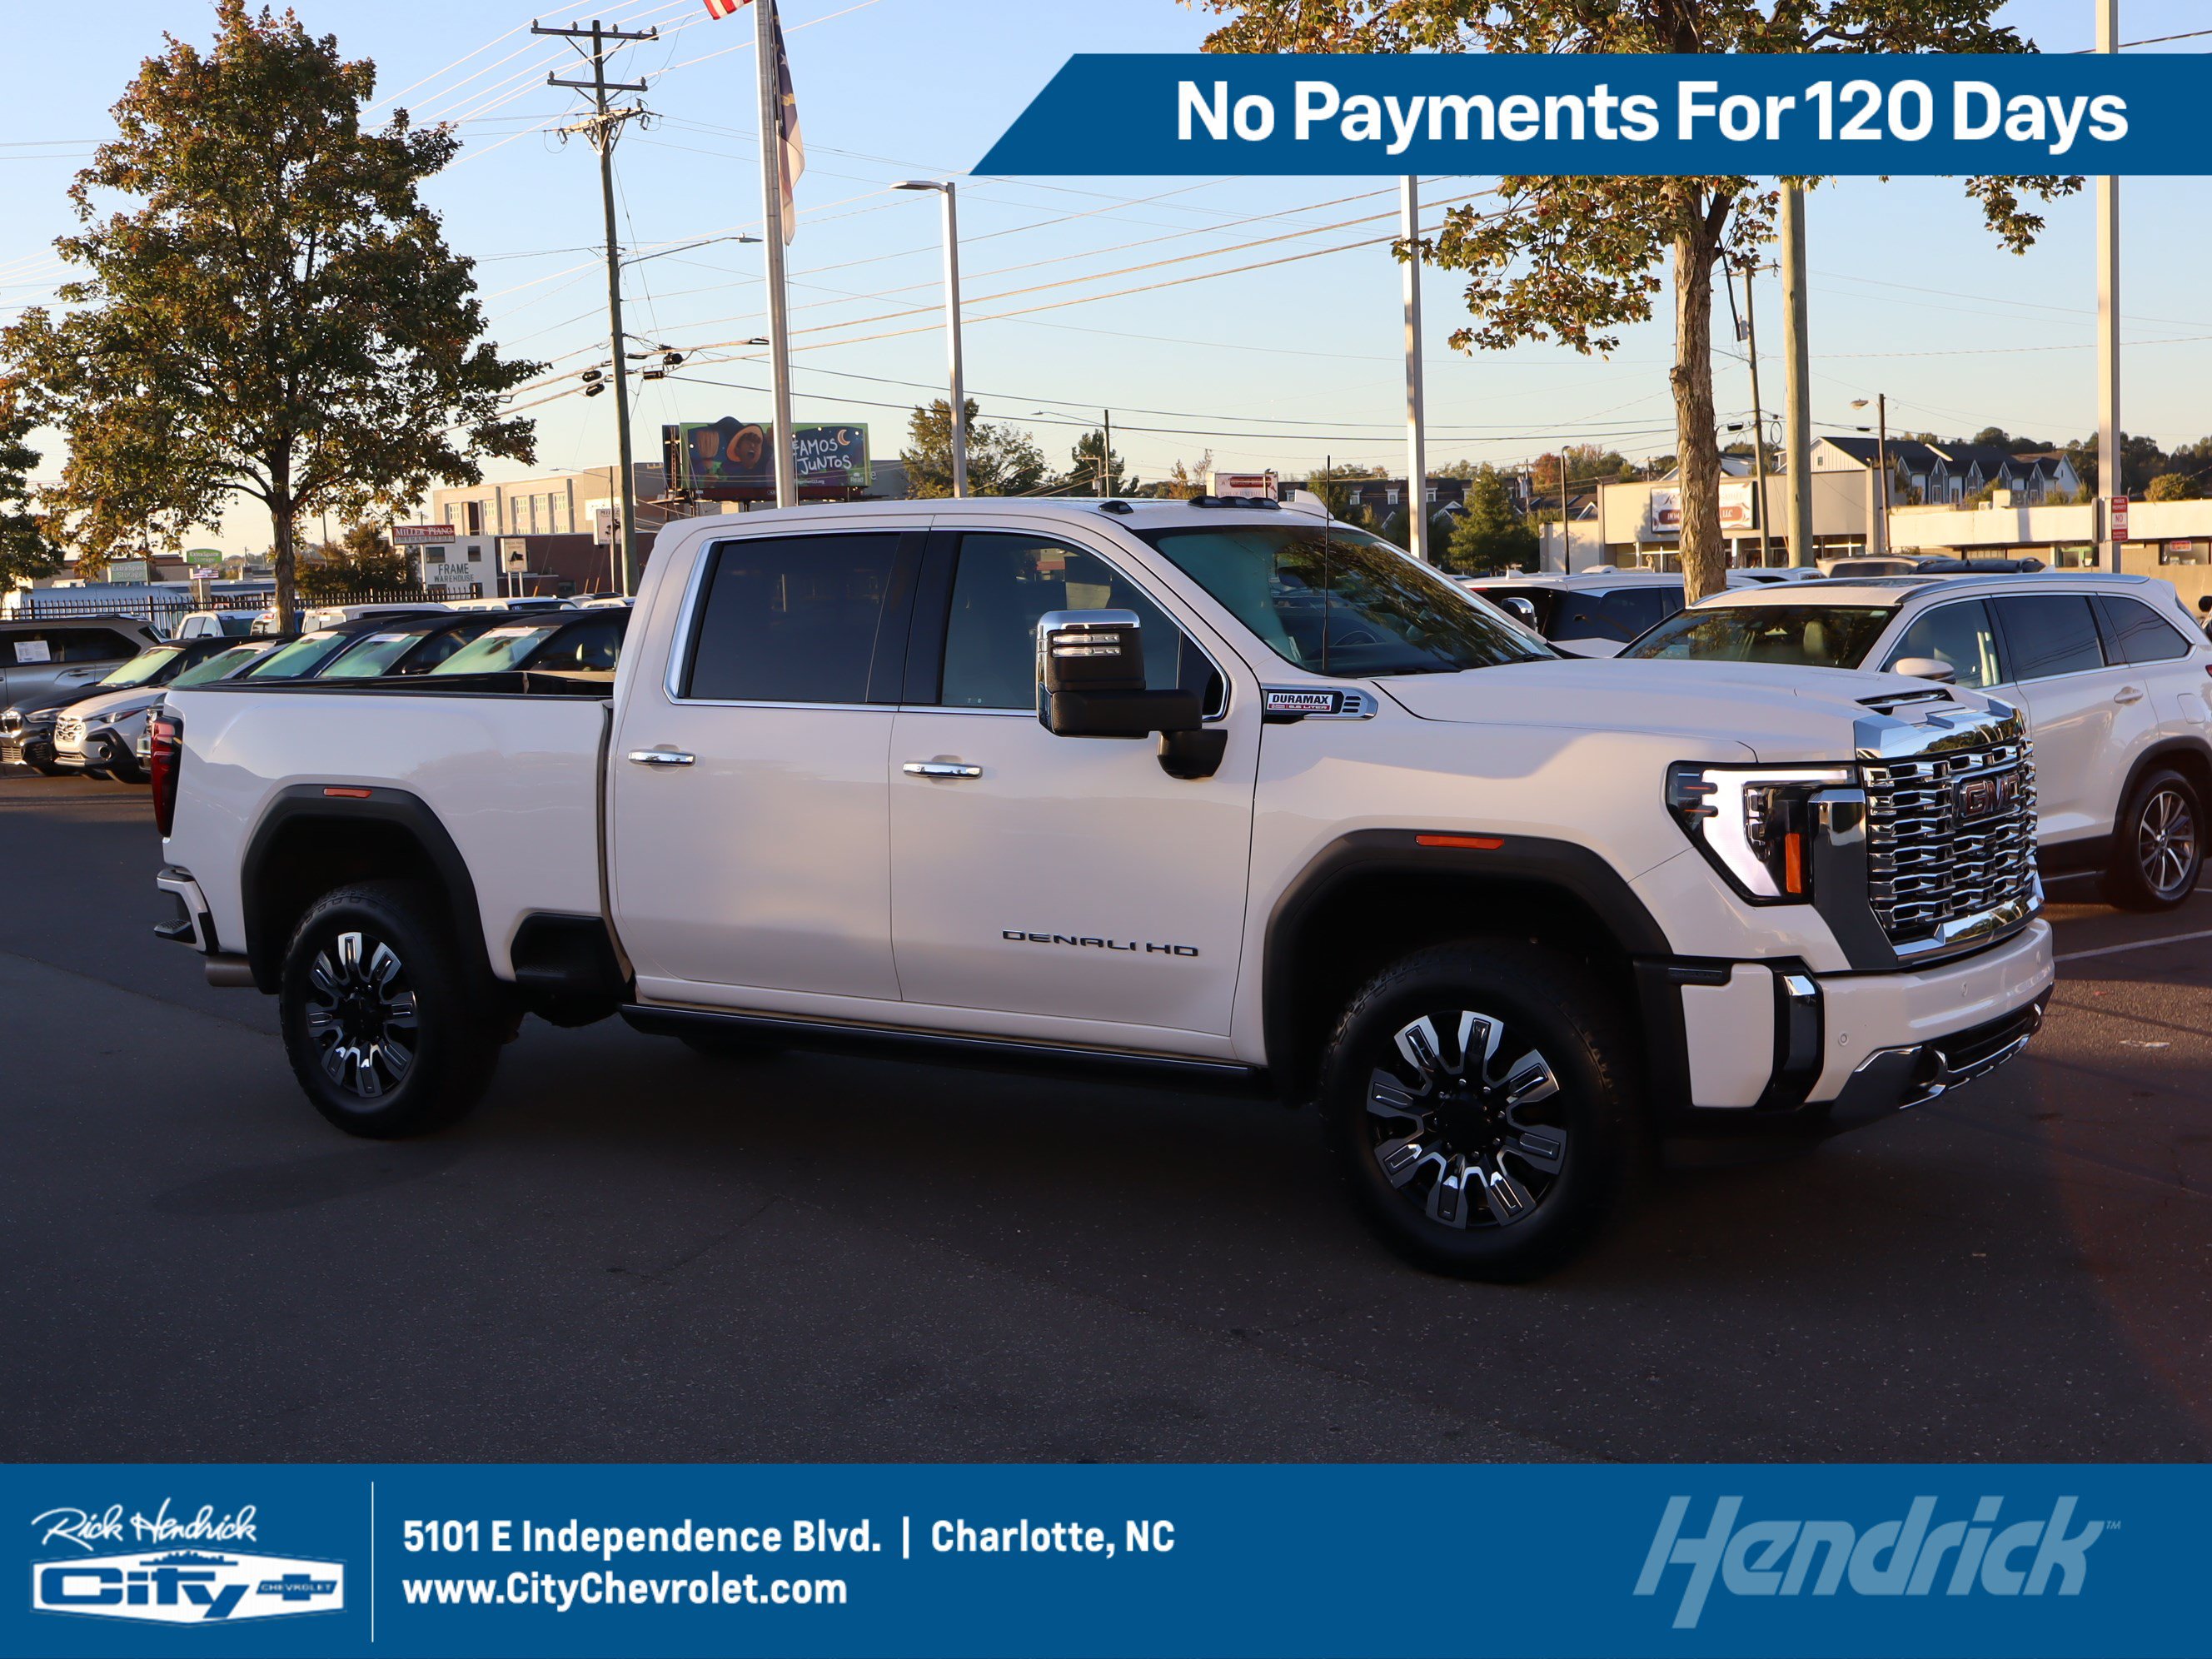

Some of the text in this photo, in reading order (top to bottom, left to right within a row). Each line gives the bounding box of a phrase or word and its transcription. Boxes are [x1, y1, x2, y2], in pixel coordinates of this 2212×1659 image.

[792, 438, 838, 456] EAMOS
[1667, 512, 1680, 521] HOM
[2115, 514, 2124, 522] NO
[428, 527, 453, 536] PIANO
[438, 563, 470, 575] FRAME
[434, 574, 474, 582] WAREHOUSE
[1273, 695, 1329, 705] DURAMAX
[1965, 773, 2020, 817] GMC
[1003, 929, 1199, 957] DENALI HD
